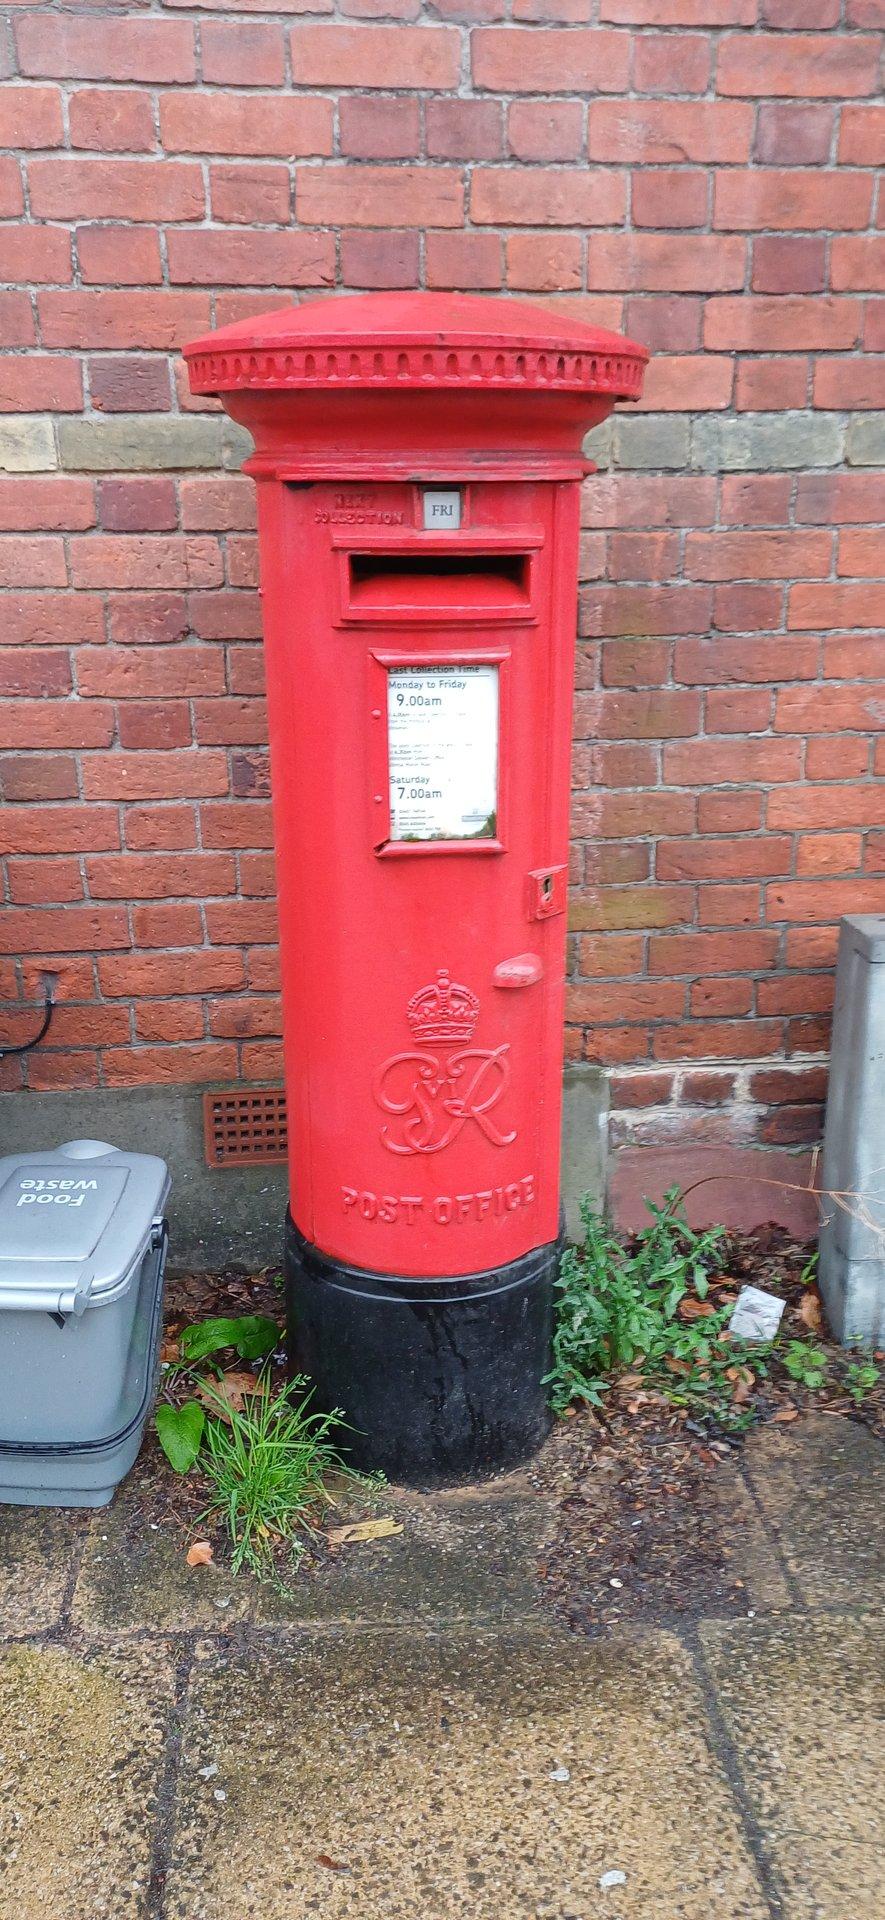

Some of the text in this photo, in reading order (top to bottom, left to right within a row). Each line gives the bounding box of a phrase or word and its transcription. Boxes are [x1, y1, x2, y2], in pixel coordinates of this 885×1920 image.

[432, 504, 453, 516] FRI
[314, 508, 404, 525] COLLECTION
[388, 664, 480, 674] Last Collection Time
[388, 679, 467, 690] Monday to Friday
[396, 693, 442, 706] 9.00am
[389, 775, 430, 785] Saturday
[397, 787, 442, 799] 7.00am
[20, 1179, 98, 1191] waste
[16, 1193, 86, 1207] Food
[341, 1174, 535, 1225] POST OFFICE
